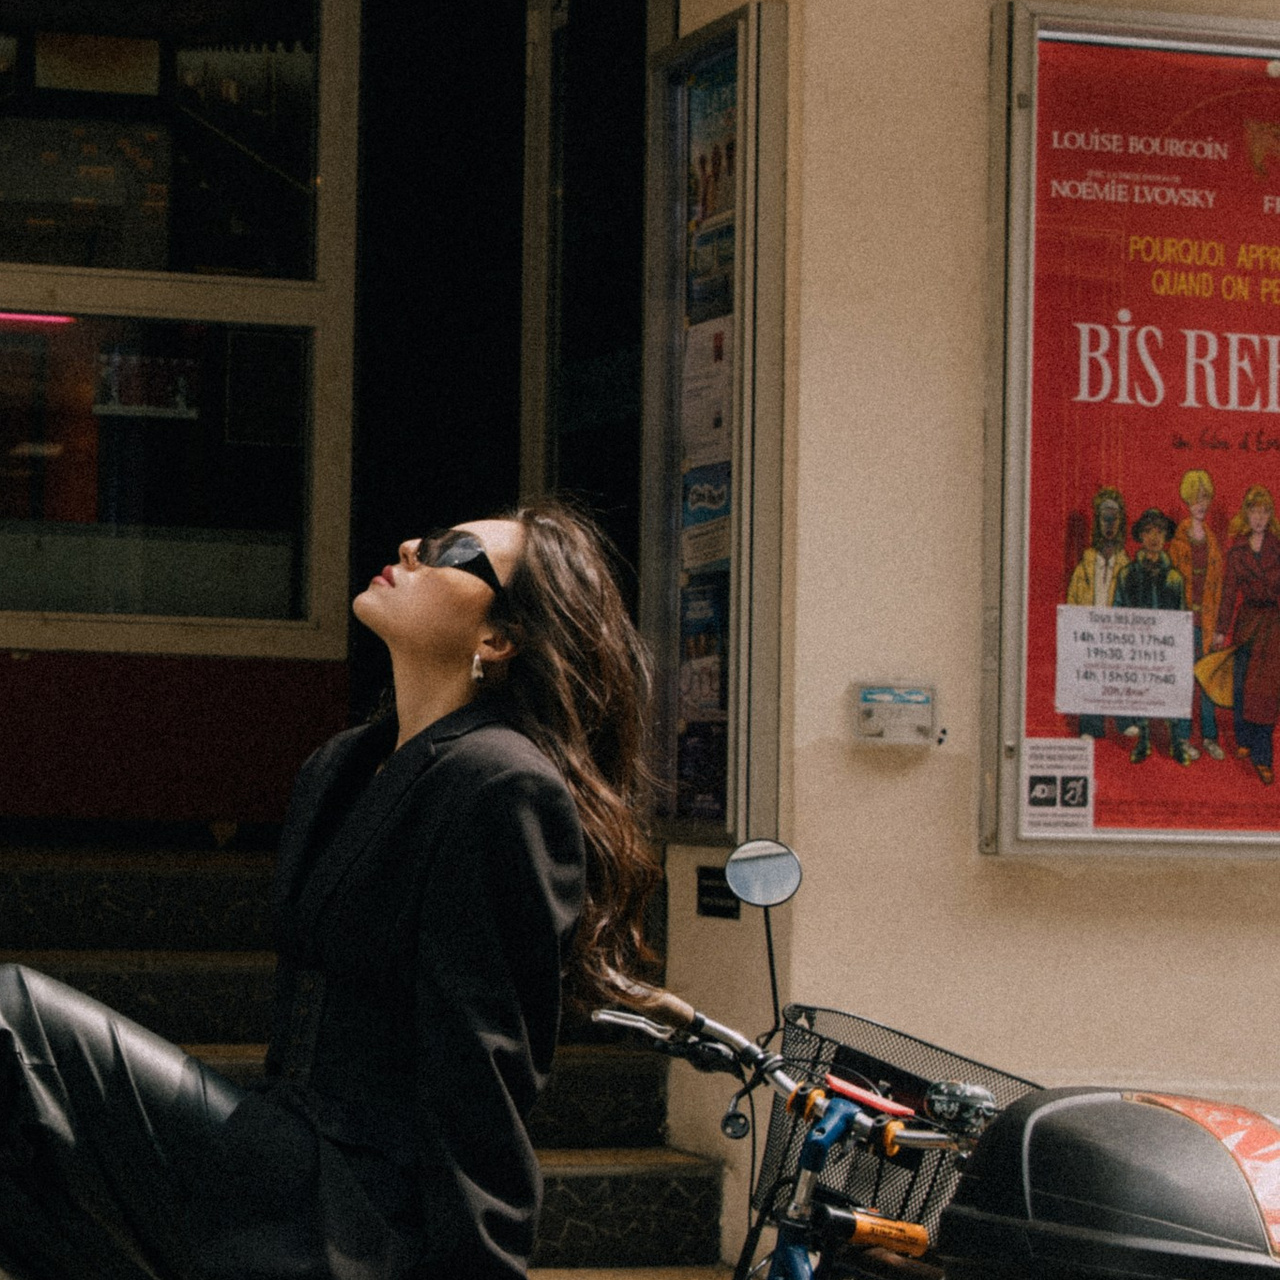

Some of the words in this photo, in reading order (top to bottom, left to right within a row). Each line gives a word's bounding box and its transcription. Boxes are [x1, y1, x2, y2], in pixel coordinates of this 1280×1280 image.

[1133, 184, 1217, 209] LVOVSKY
[1128, 236, 1225, 267] POURQUOI
[1151, 268, 1214, 298] QUAND
[1221, 274, 1249, 301] ON
